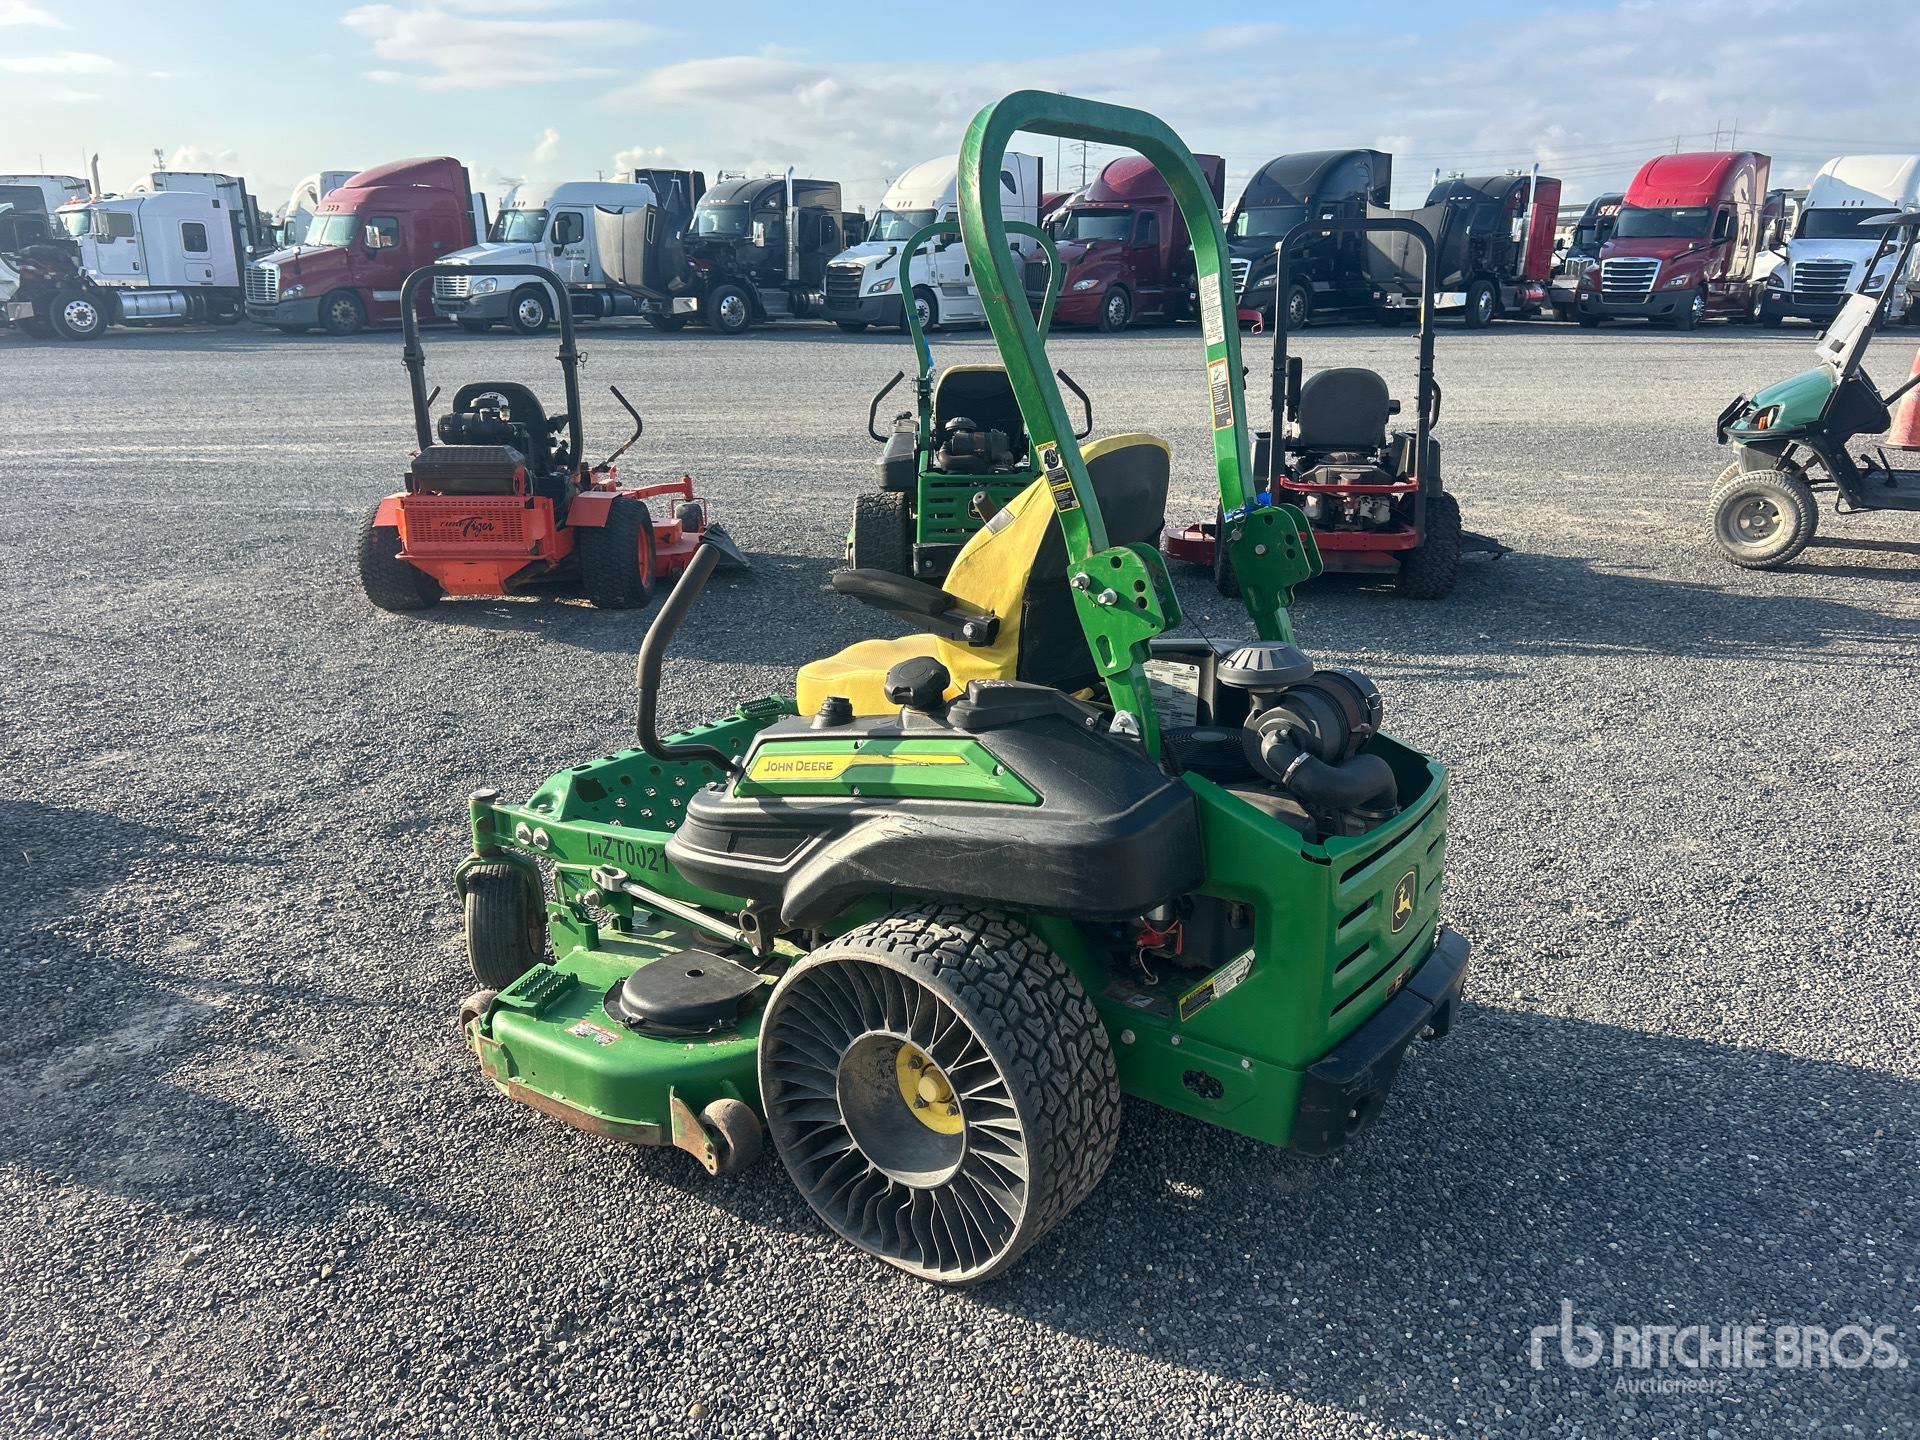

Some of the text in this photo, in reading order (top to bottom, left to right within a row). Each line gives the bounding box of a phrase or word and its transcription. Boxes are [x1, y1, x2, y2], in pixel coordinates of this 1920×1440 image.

[458, 516, 494, 537] Tiger
[763, 760, 834, 772] JOHN DEERE
